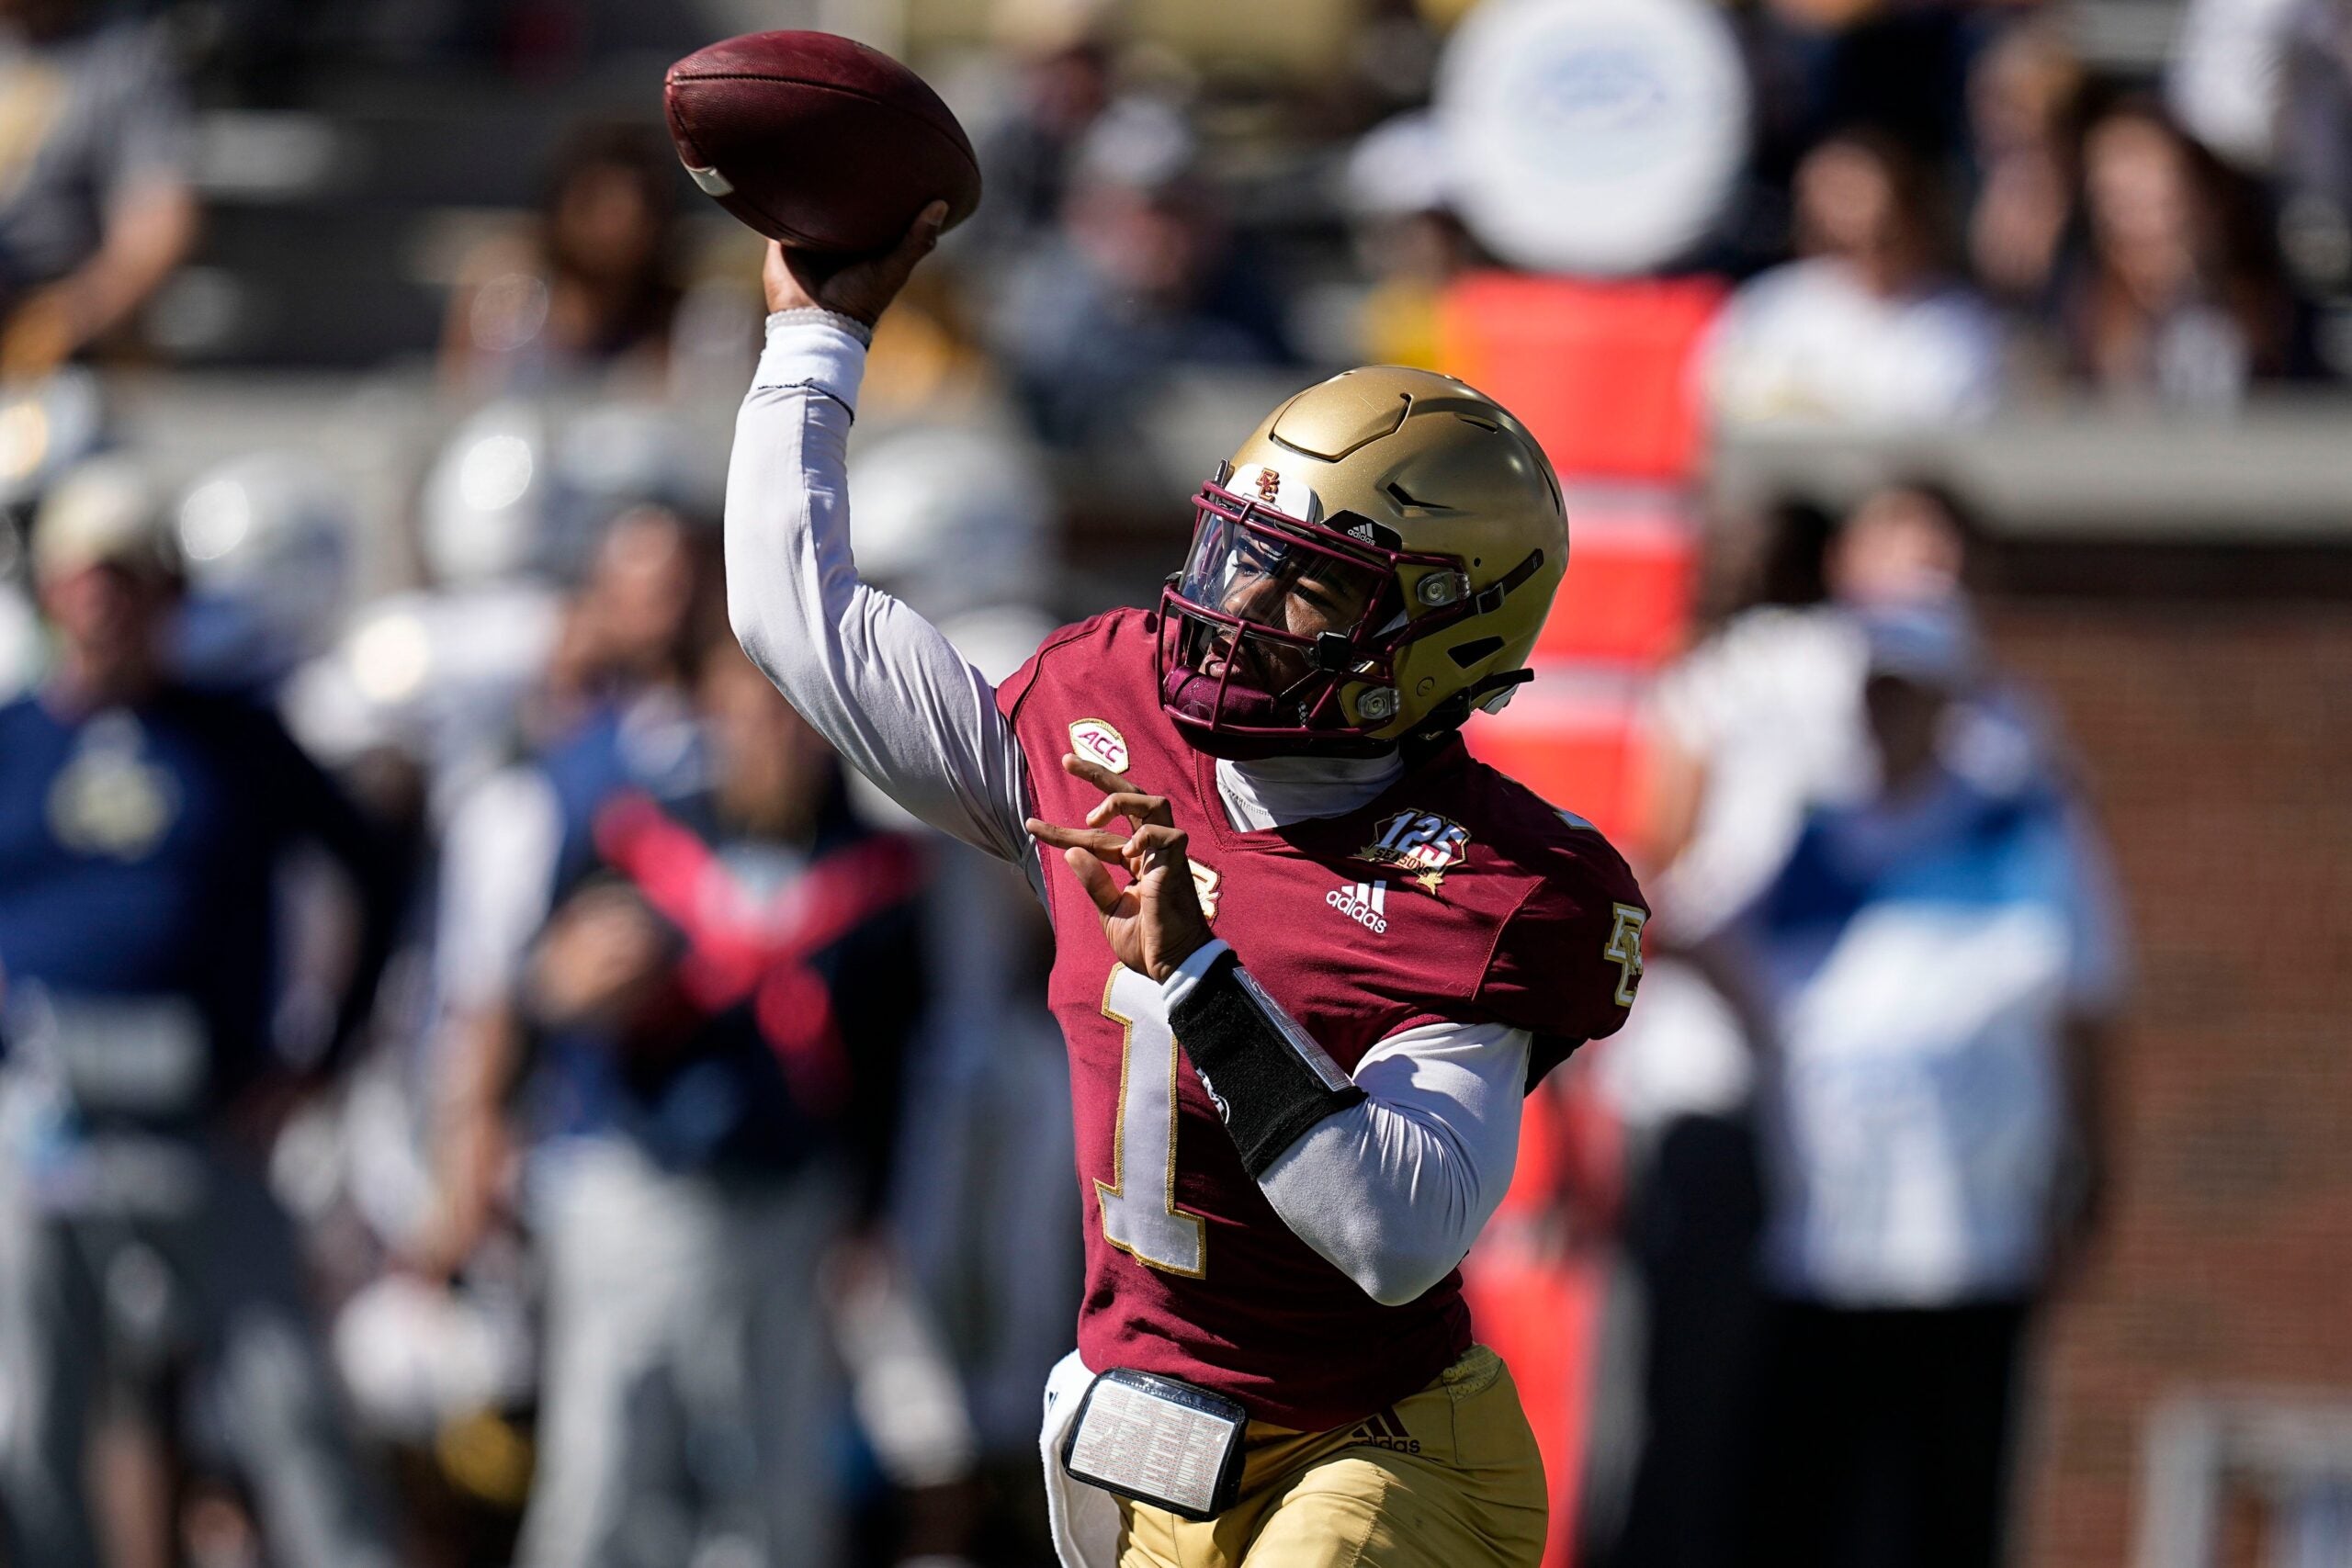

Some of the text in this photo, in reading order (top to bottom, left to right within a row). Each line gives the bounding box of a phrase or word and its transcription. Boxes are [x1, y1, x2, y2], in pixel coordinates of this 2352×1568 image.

[1347, 529, 1377, 547] adidas
[1078, 731, 1125, 763] ACC
[1375, 811, 1466, 871] 125
[1374, 847, 1433, 877] SEASONS
[1326, 890, 1387, 934] adidas
[1092, 961, 1206, 1280] 1
